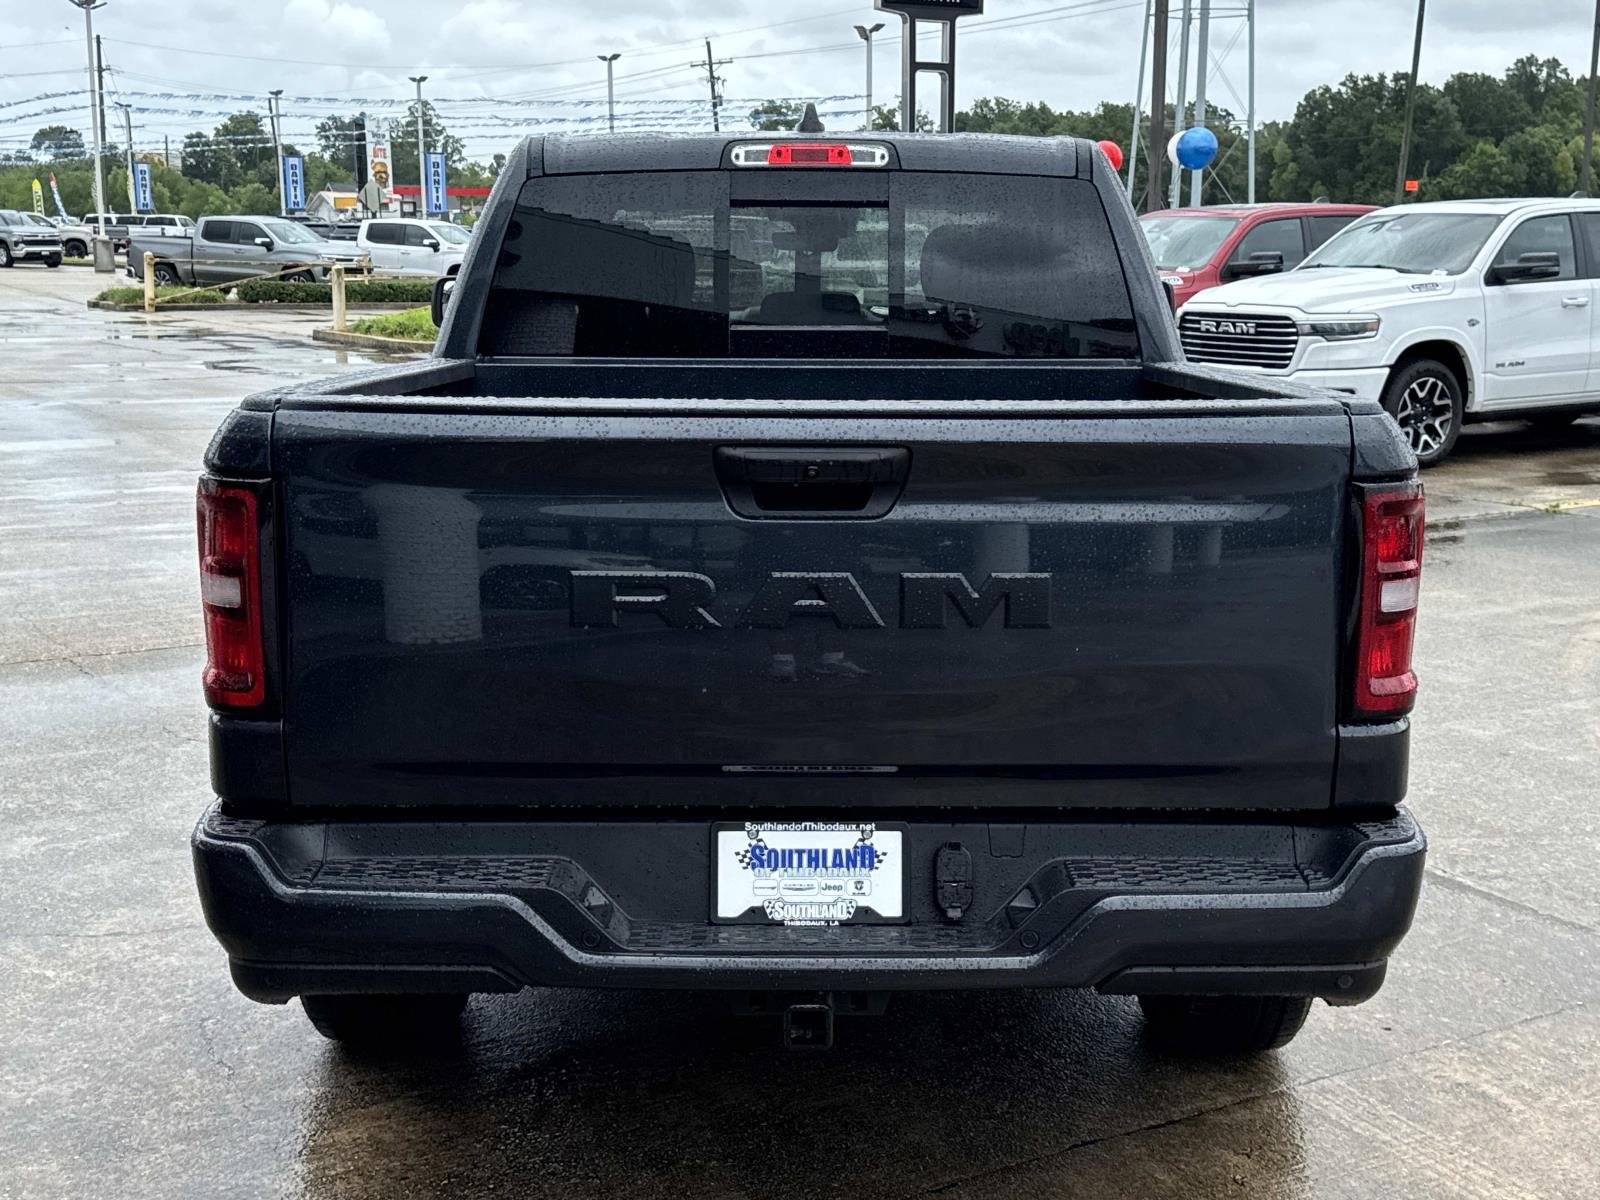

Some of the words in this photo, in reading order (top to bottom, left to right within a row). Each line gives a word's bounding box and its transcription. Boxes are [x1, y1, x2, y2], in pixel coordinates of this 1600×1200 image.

[432, 161, 442, 211] BANTIN
[1200, 320, 1257, 335] RAM
[569, 570, 1053, 629] RAM
[744, 821, 876, 831] SouthlandofThibodaux.net
[750, 844, 875, 872] SOUTHLAND
[821, 883, 843, 893] Jeep
[773, 901, 847, 919] SOUTHLAND
